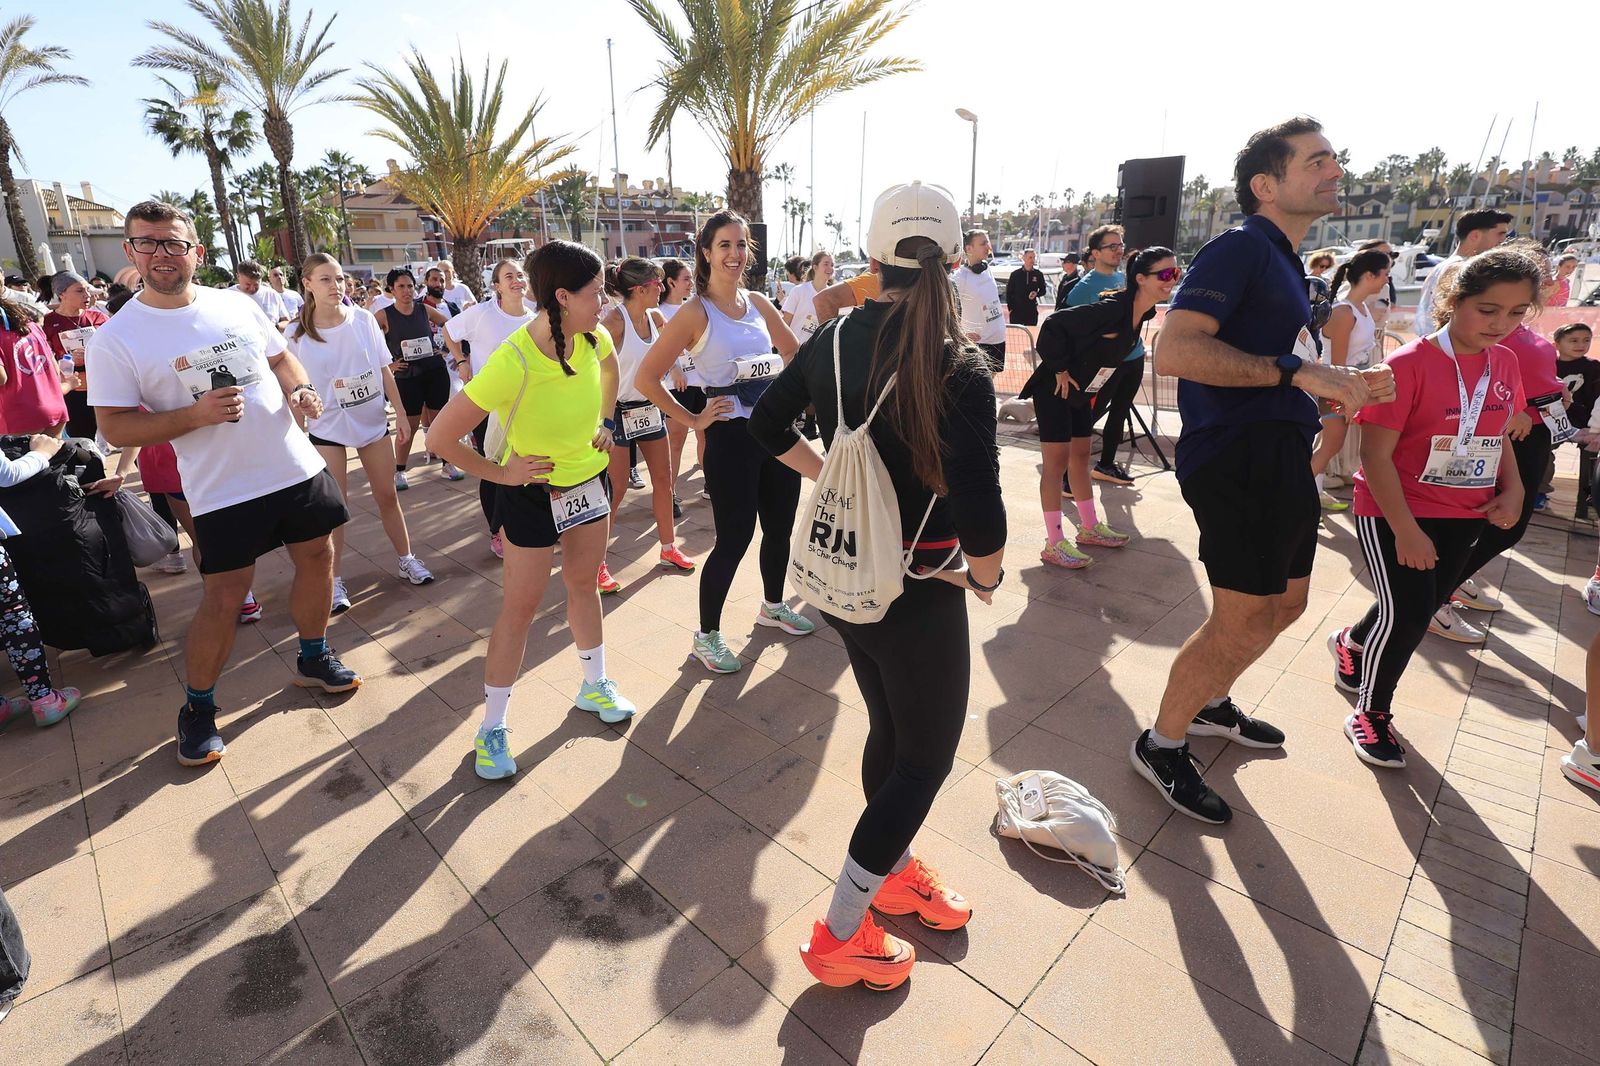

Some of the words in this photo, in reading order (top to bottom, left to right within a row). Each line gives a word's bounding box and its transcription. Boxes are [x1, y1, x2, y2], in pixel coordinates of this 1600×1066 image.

[1181, 287, 1205, 297] NIKE
[1204, 289, 1228, 303] PRO
[211, 341, 237, 354] RUN
[413, 347, 423, 355] 40
[360, 370, 373, 380] RUN
[750, 361, 771, 378] 203
[350, 385, 370, 400] 161
[1445, 404, 1504, 415] INMLADA
[633, 416, 651, 430] 156
[1445, 469, 1467, 477] RUN
[565, 494, 590, 517] 234
[814, 504, 836, 523] The
